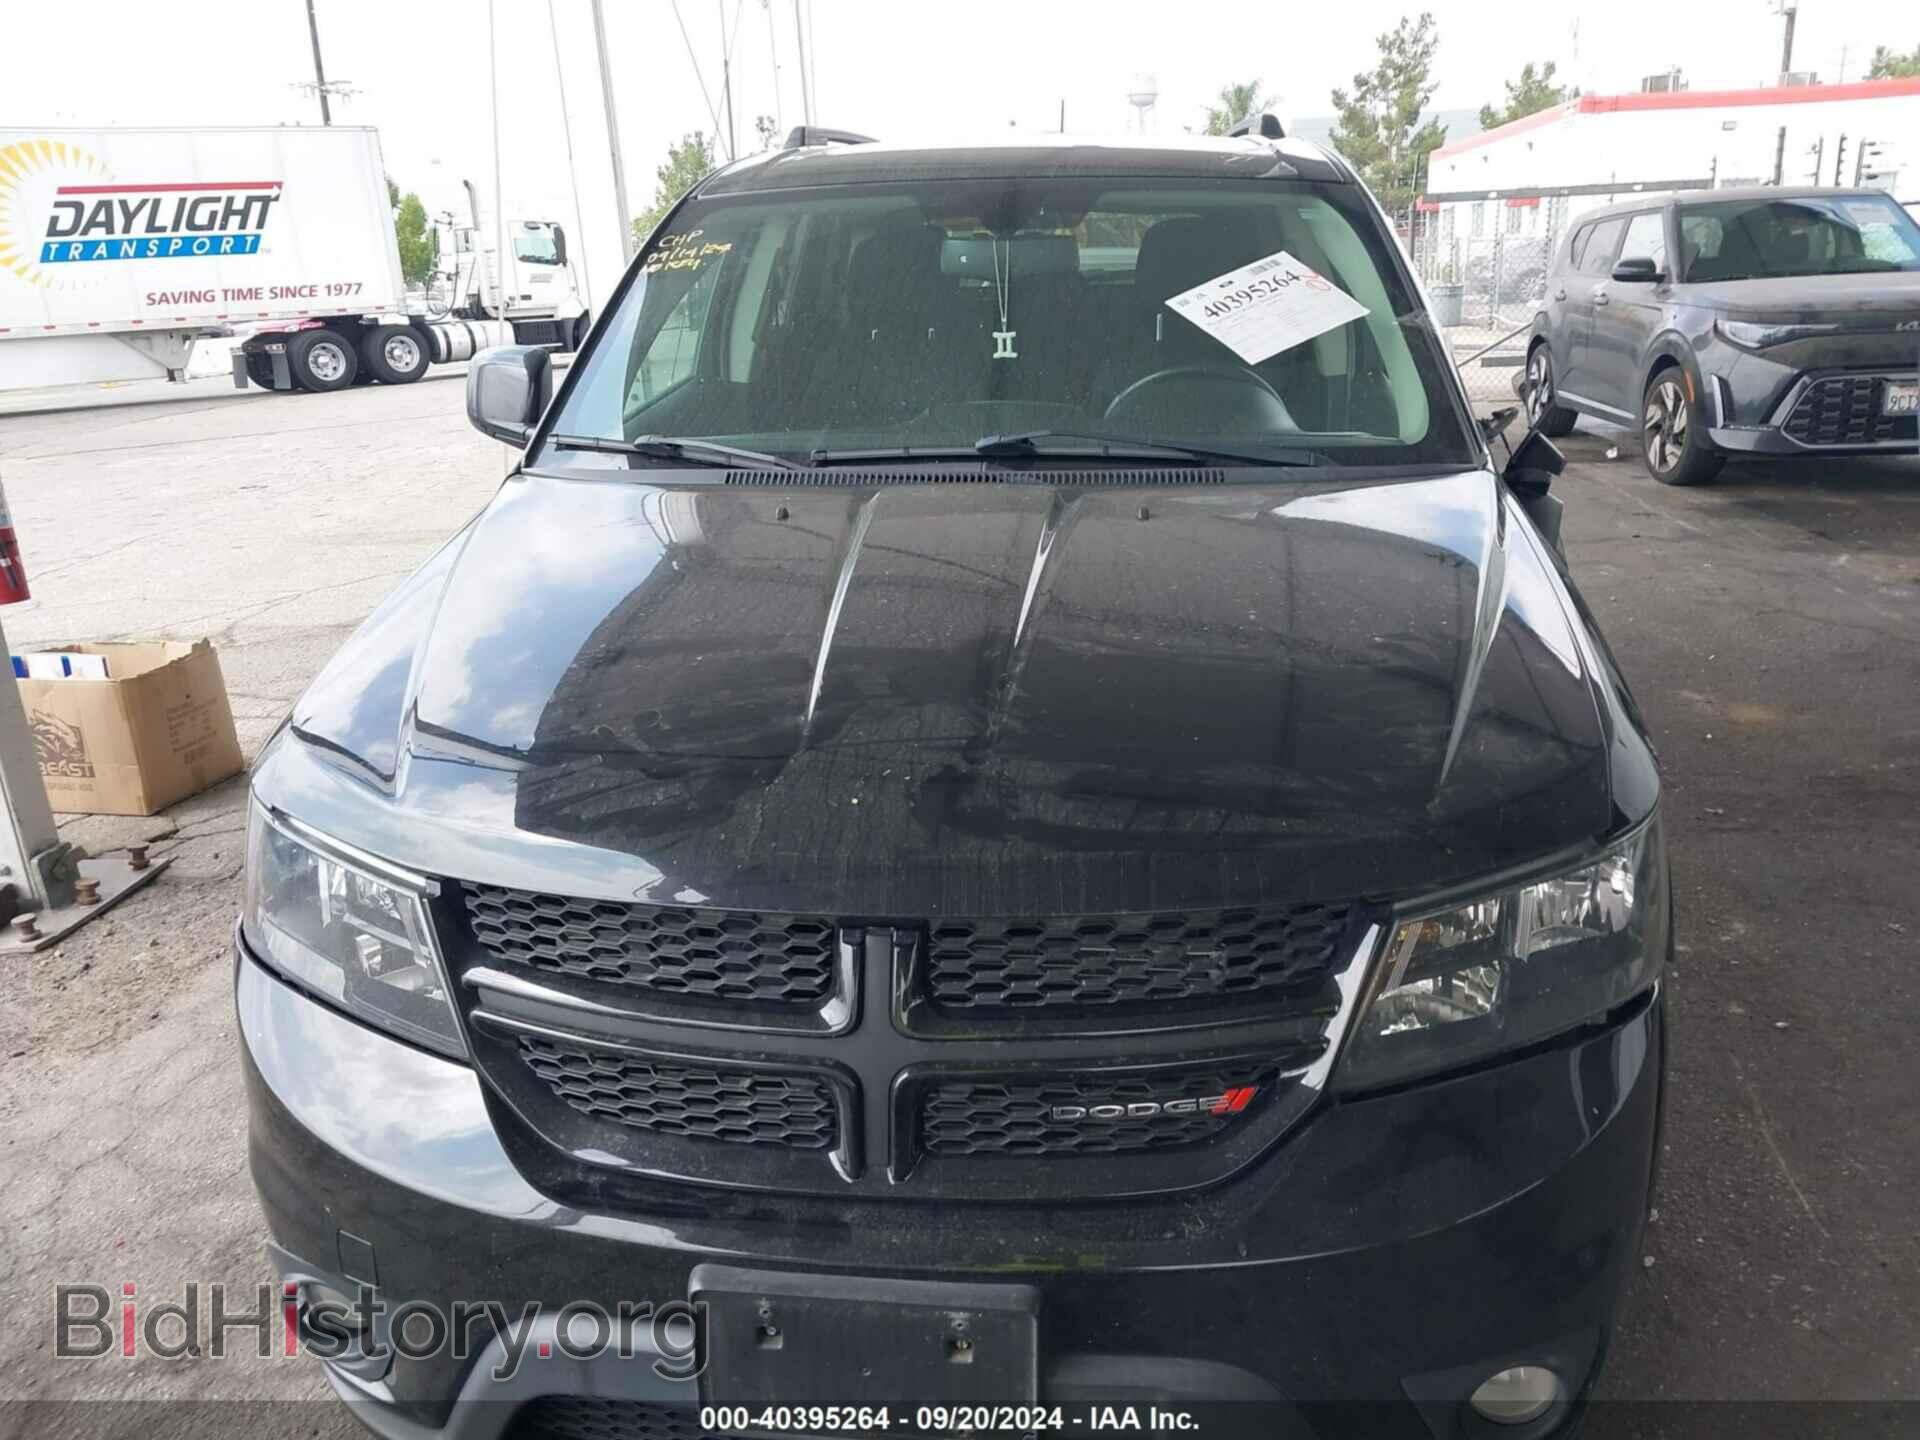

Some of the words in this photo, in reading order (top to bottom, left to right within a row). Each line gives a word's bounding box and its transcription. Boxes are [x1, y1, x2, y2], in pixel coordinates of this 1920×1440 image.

[46, 194, 281, 237] DAYLIGHT
[48, 236, 256, 260] TRANSPORT
[146, 291, 216, 306] SAVING
[221, 287, 264, 301] TIME
[268, 284, 318, 300] SINCE
[324, 282, 363, 297] 1977
[1203, 269, 1301, 319] 40395264
[1052, 1096, 1230, 1120] DODGE
